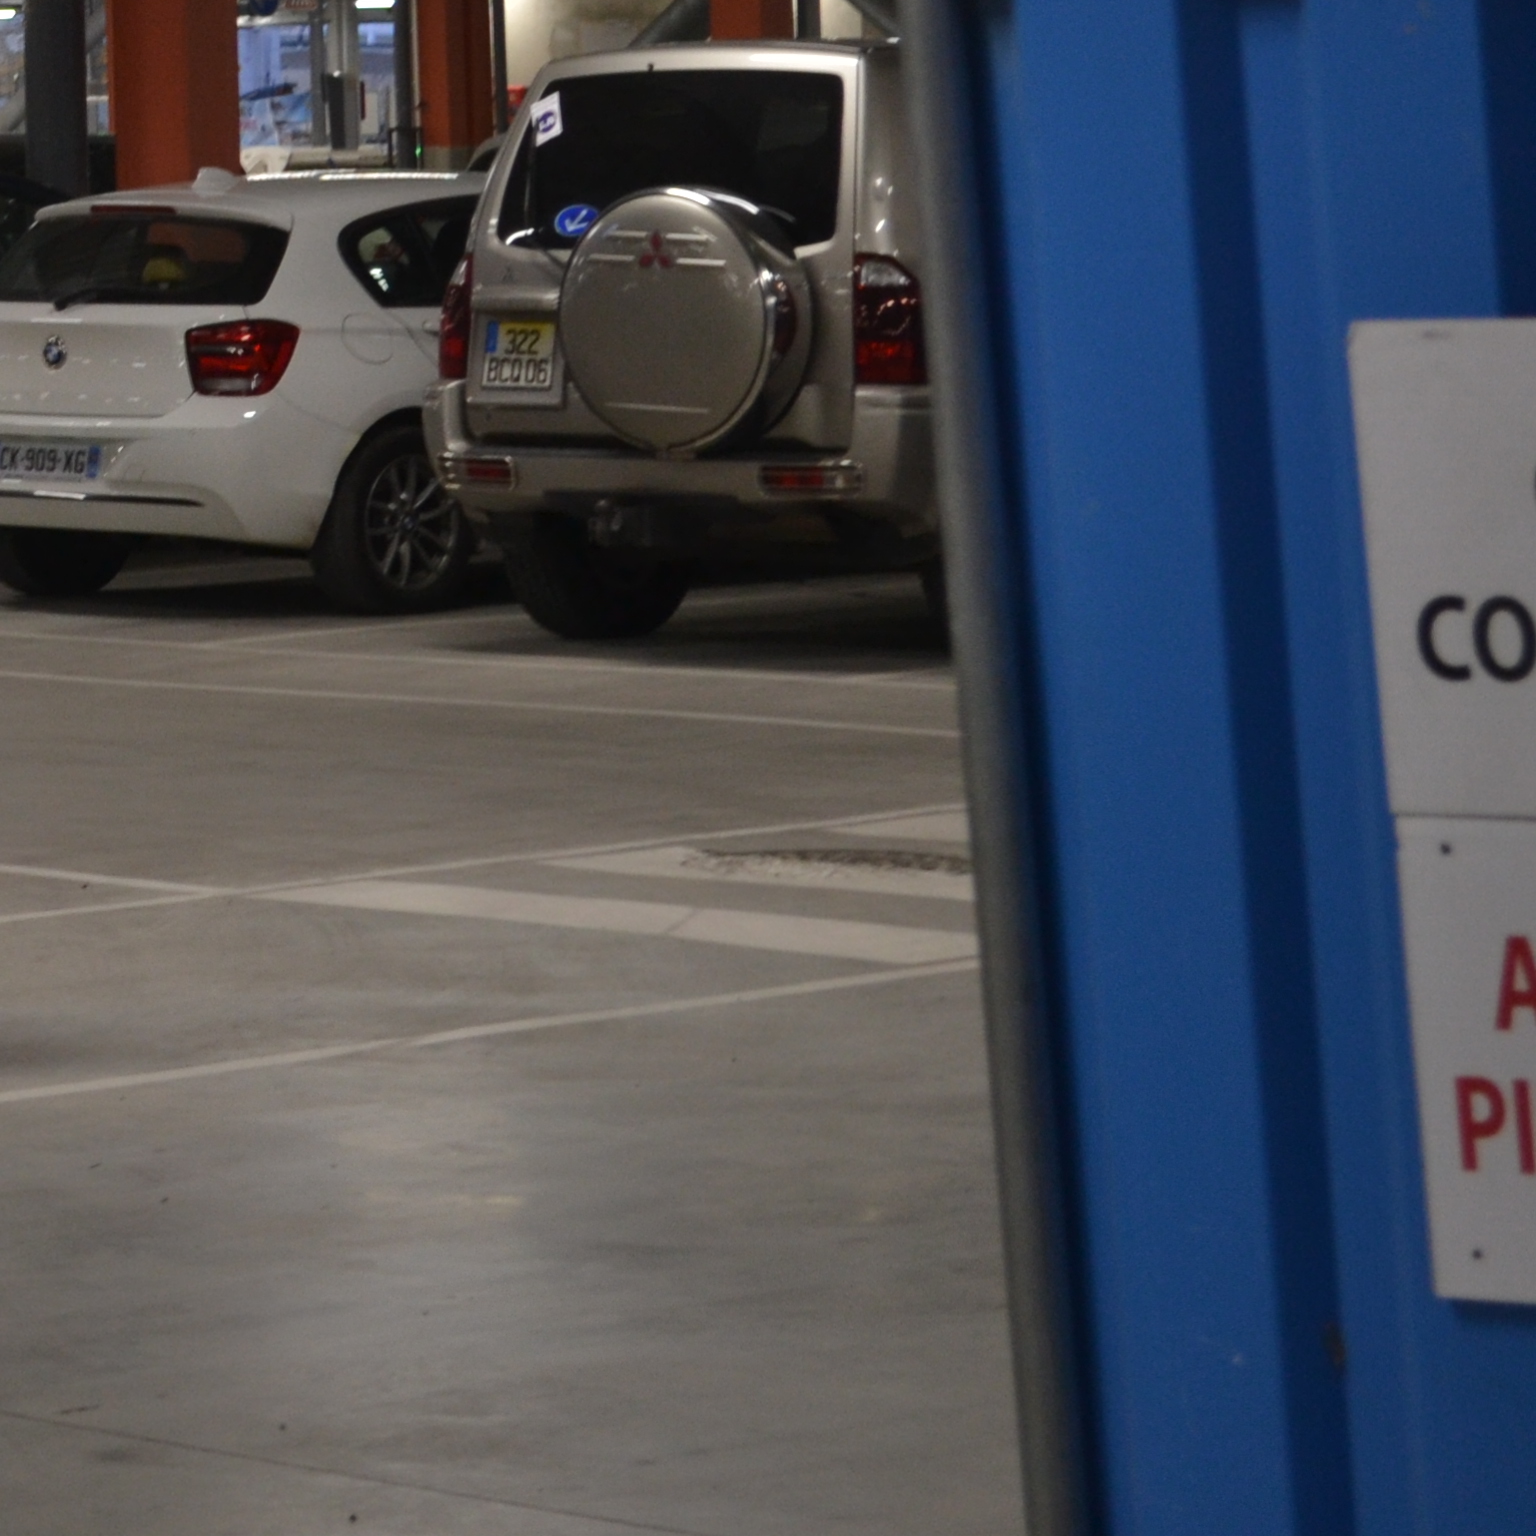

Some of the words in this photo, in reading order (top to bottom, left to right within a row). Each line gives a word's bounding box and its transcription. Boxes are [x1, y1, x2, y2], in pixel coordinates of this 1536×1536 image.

[504, 328, 541, 355] 322
[525, 358, 549, 383] 06
[0, 446, 86, 474] CK-909-XG
